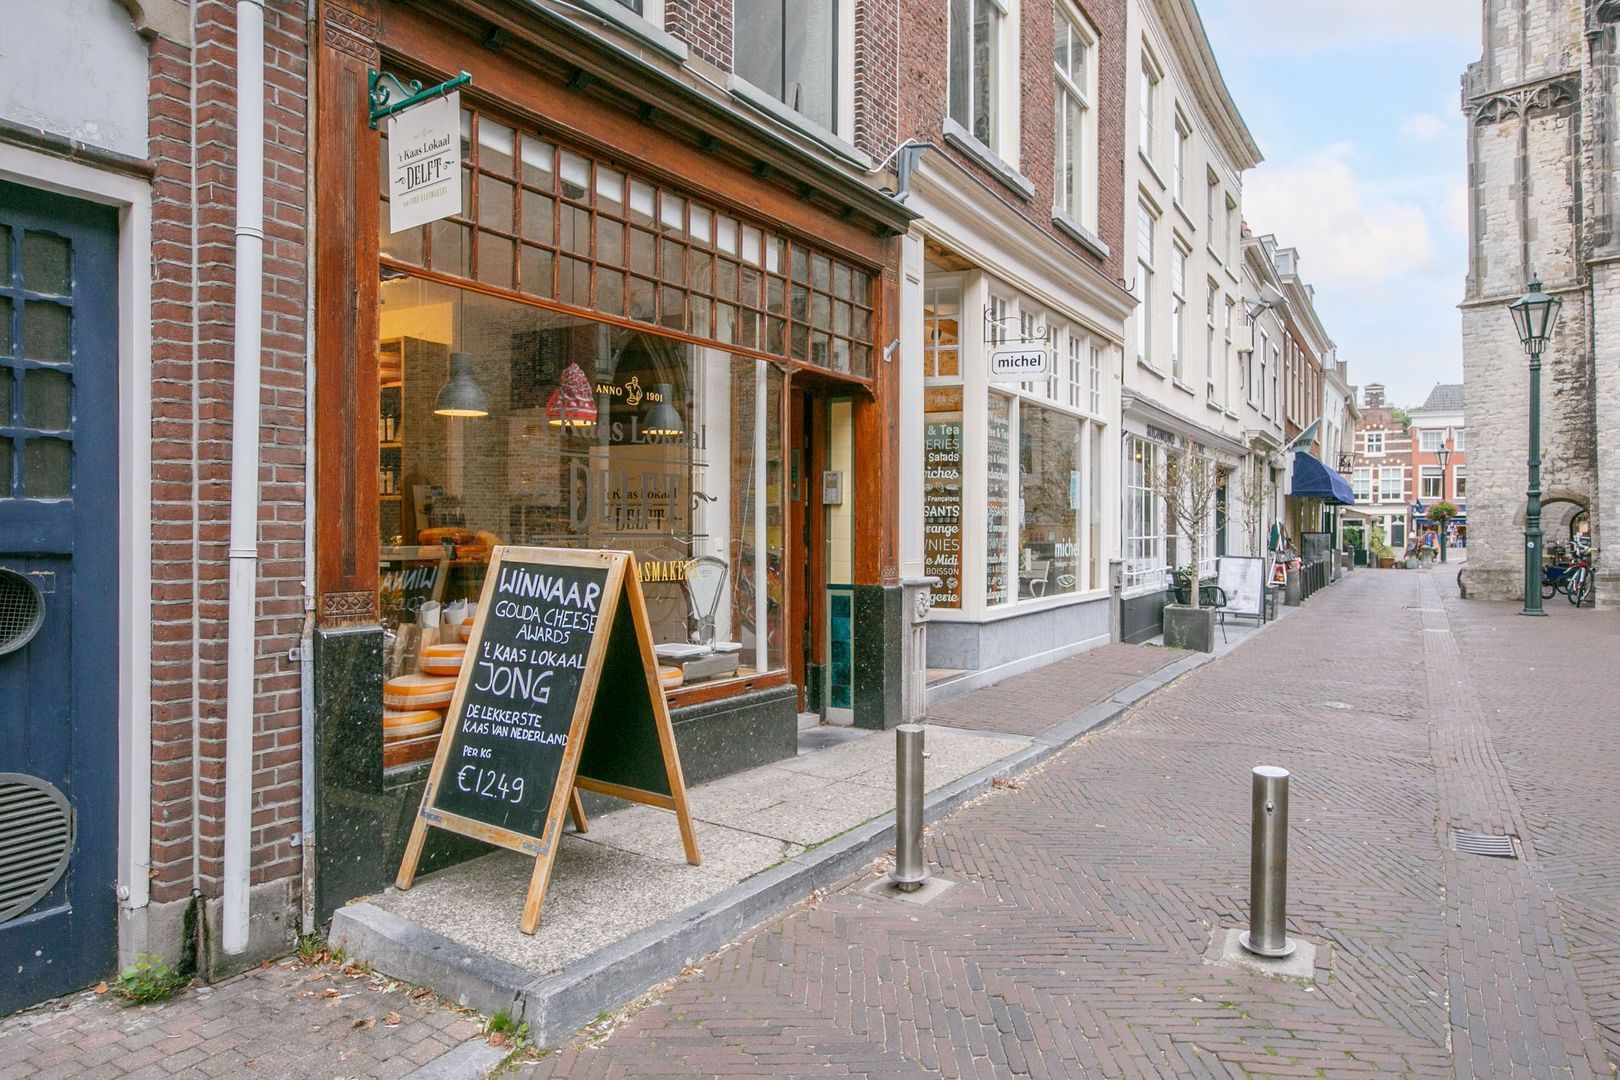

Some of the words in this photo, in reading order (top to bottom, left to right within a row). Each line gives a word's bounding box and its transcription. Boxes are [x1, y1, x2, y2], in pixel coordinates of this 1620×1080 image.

[404, 147, 423, 161] Kaas
[423, 133, 450, 153] Lokaal
[406, 157, 442, 190] DELFT
[998, 354, 1041, 368] michel
[596, 384, 623, 396] ANNO
[646, 392, 663, 402] 1901
[631, 415, 707, 450] Lokaal
[927, 425, 937, 436] &
[939, 424, 960, 436] Tea
[928, 452, 960, 462] Salads
[569, 461, 682, 530] DELFT
[924, 506, 960, 517] SANTS
[1055, 536, 1080, 558] michel
[926, 567, 960, 576] BOISSON
[934, 553, 959, 567] Midi
[495, 600, 541, 623] GOUDA
[544, 608, 599, 634] CHEESE
[516, 623, 571, 644] AWARDS
[493, 642, 527, 663] KAAS
[531, 650, 586, 670] LOKAAL
[474, 661, 554, 704] JONG
[466, 703, 480, 719] DE
[480, 705, 543, 728] LEKKERSTE
[462, 719, 489, 735] KAAS
[491, 722, 509, 738] VAN
[510, 727, 569, 747] NEDERLAND
[462, 744, 478, 758] PER
[480, 748, 492, 759] KG
[457, 765, 525, 804] €12.49
